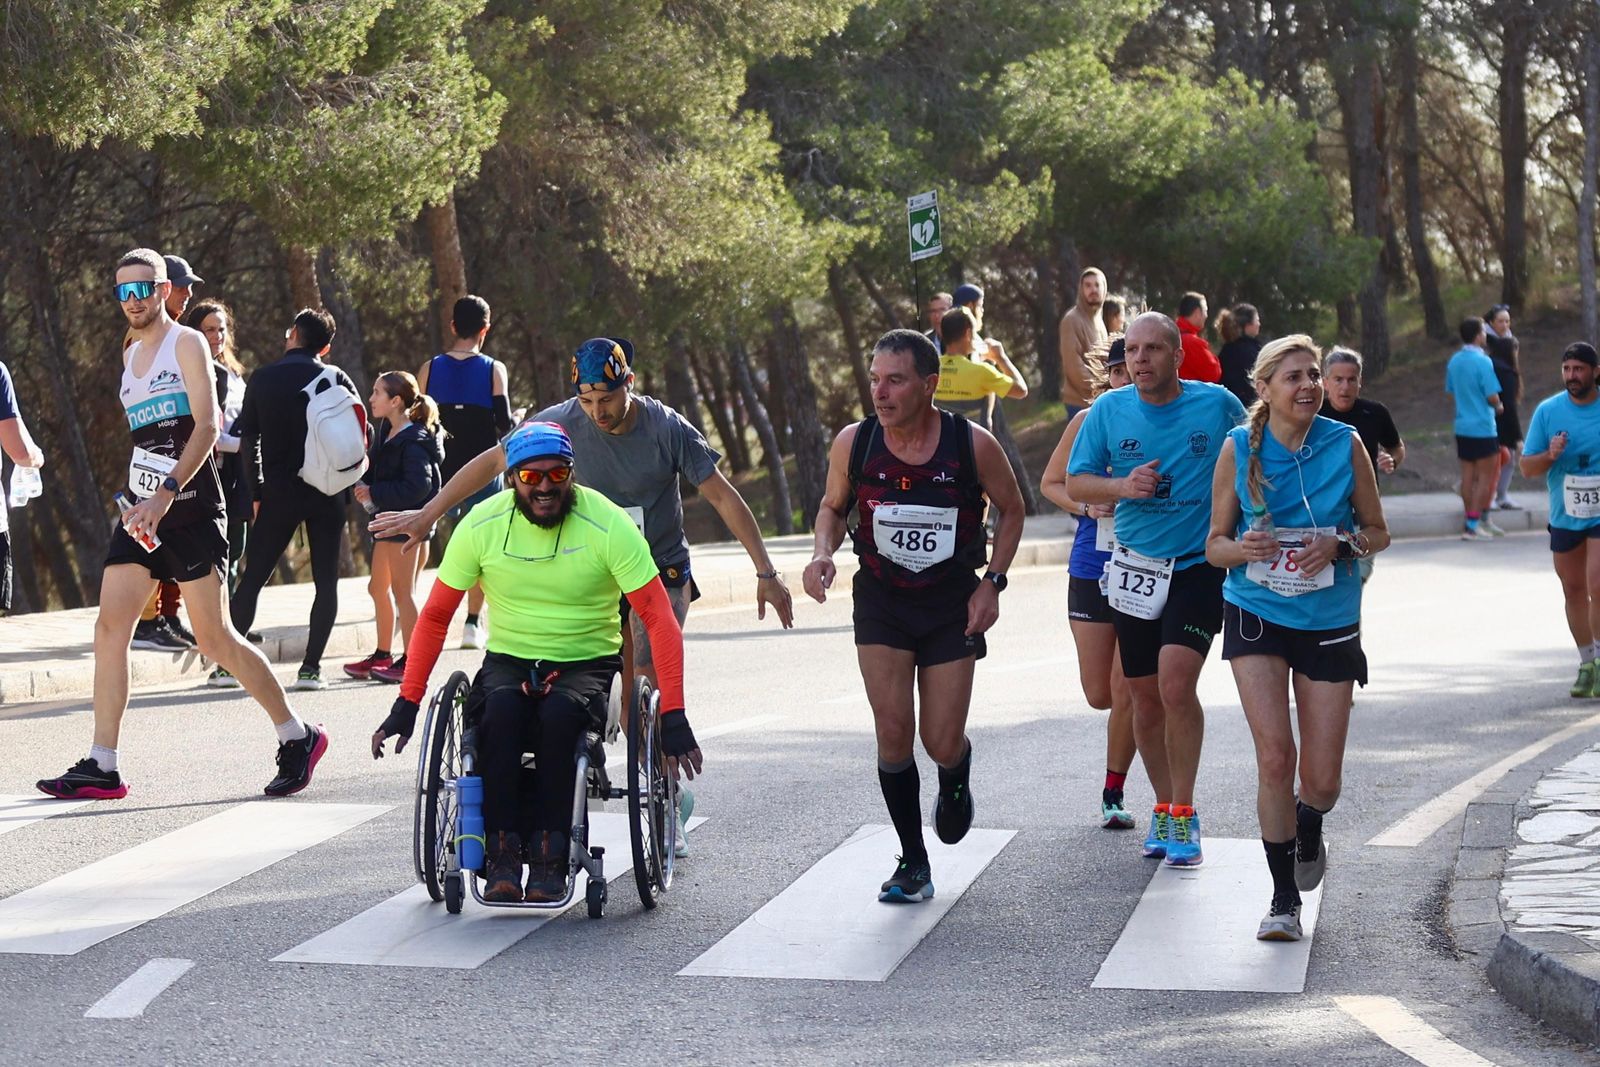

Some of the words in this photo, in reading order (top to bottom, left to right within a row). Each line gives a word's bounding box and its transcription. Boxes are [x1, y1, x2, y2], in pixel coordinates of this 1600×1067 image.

[126, 400, 177, 430] nacua
[1573, 491, 1600, 505] 343
[891, 530, 938, 553] 486
[1118, 571, 1157, 598] 123
